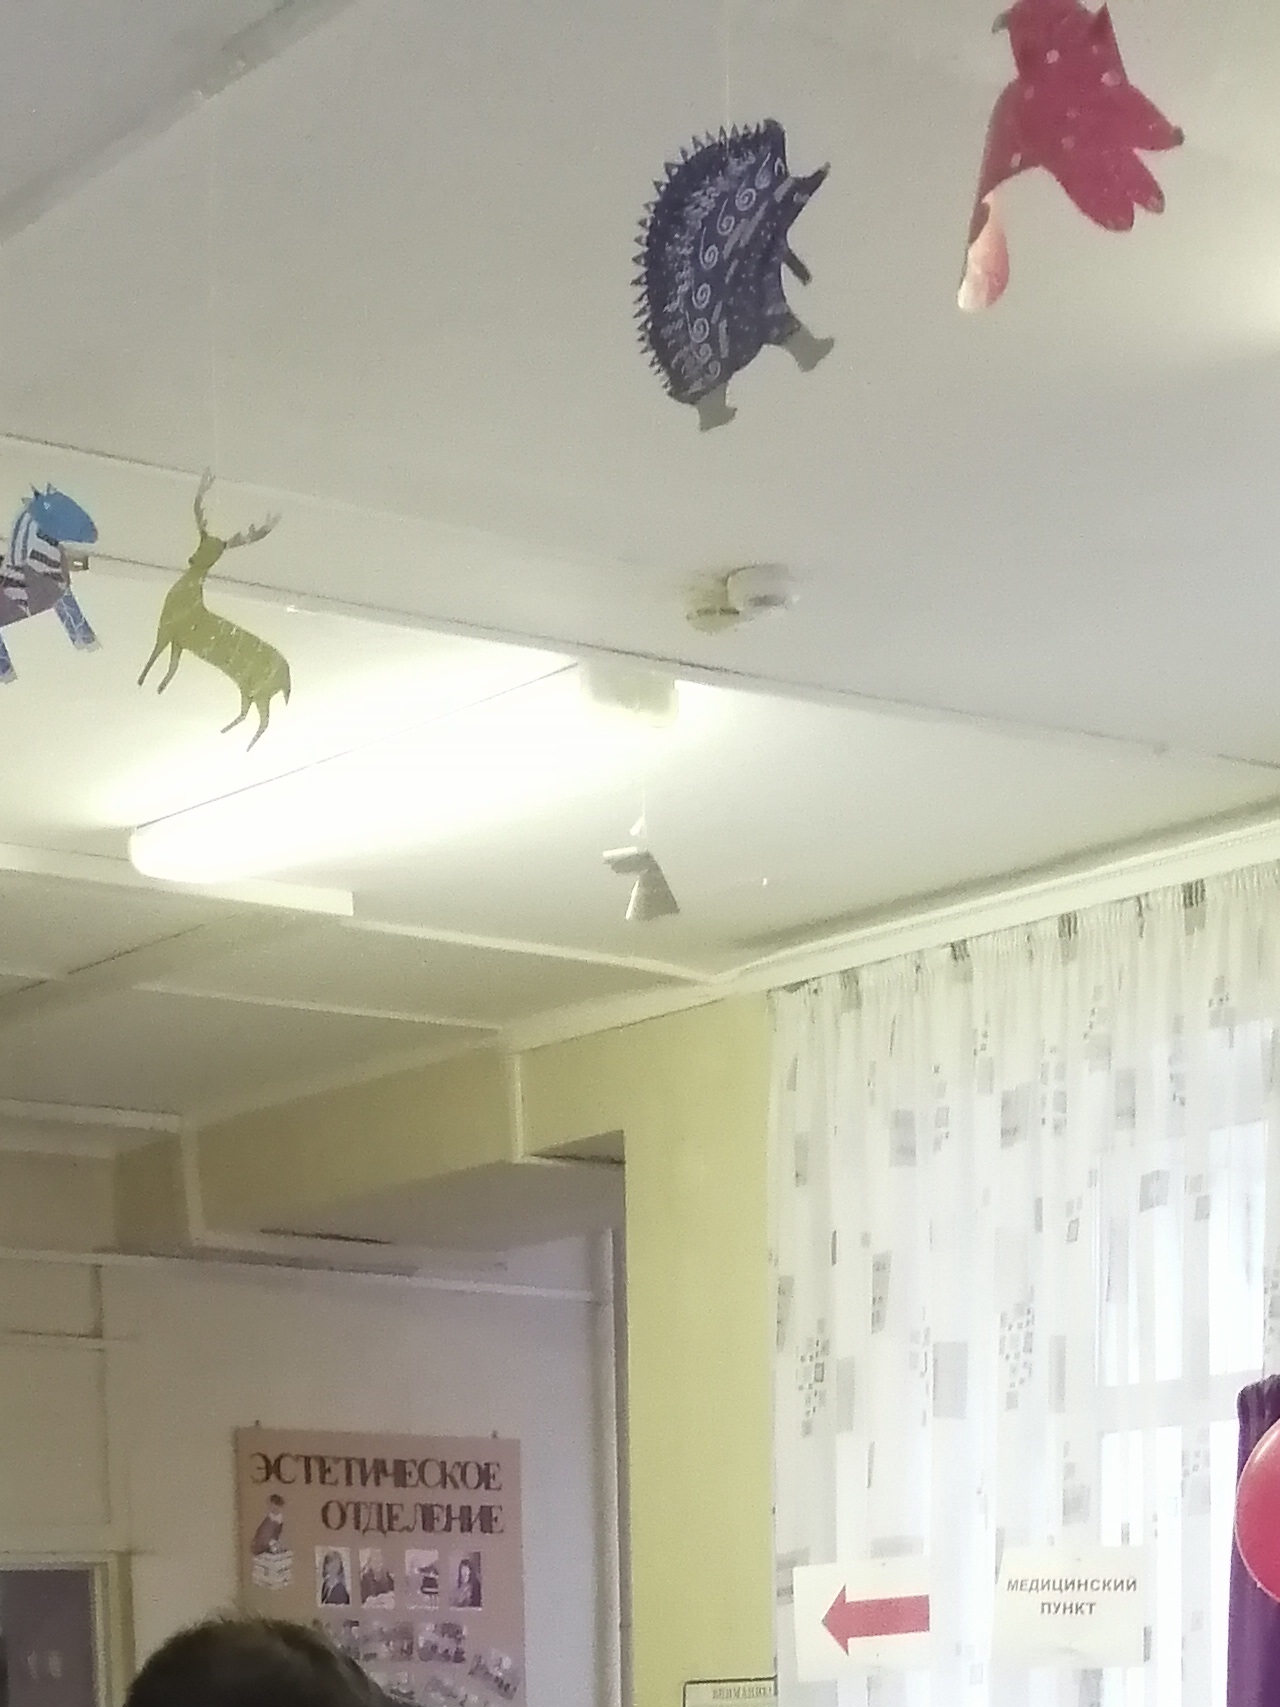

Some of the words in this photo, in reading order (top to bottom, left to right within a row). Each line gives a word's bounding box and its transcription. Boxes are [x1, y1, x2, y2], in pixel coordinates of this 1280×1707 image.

[250, 1452, 503, 1491] ЭСТЕТИЧЕСКОЕ
[321, 1500, 505, 1536] ОТДЕЛЕНИЕ
[1006, 1576, 1137, 1593] МЕДИЦИНСКИЙ
[1040, 1602, 1096, 1615] ПУНКТ
